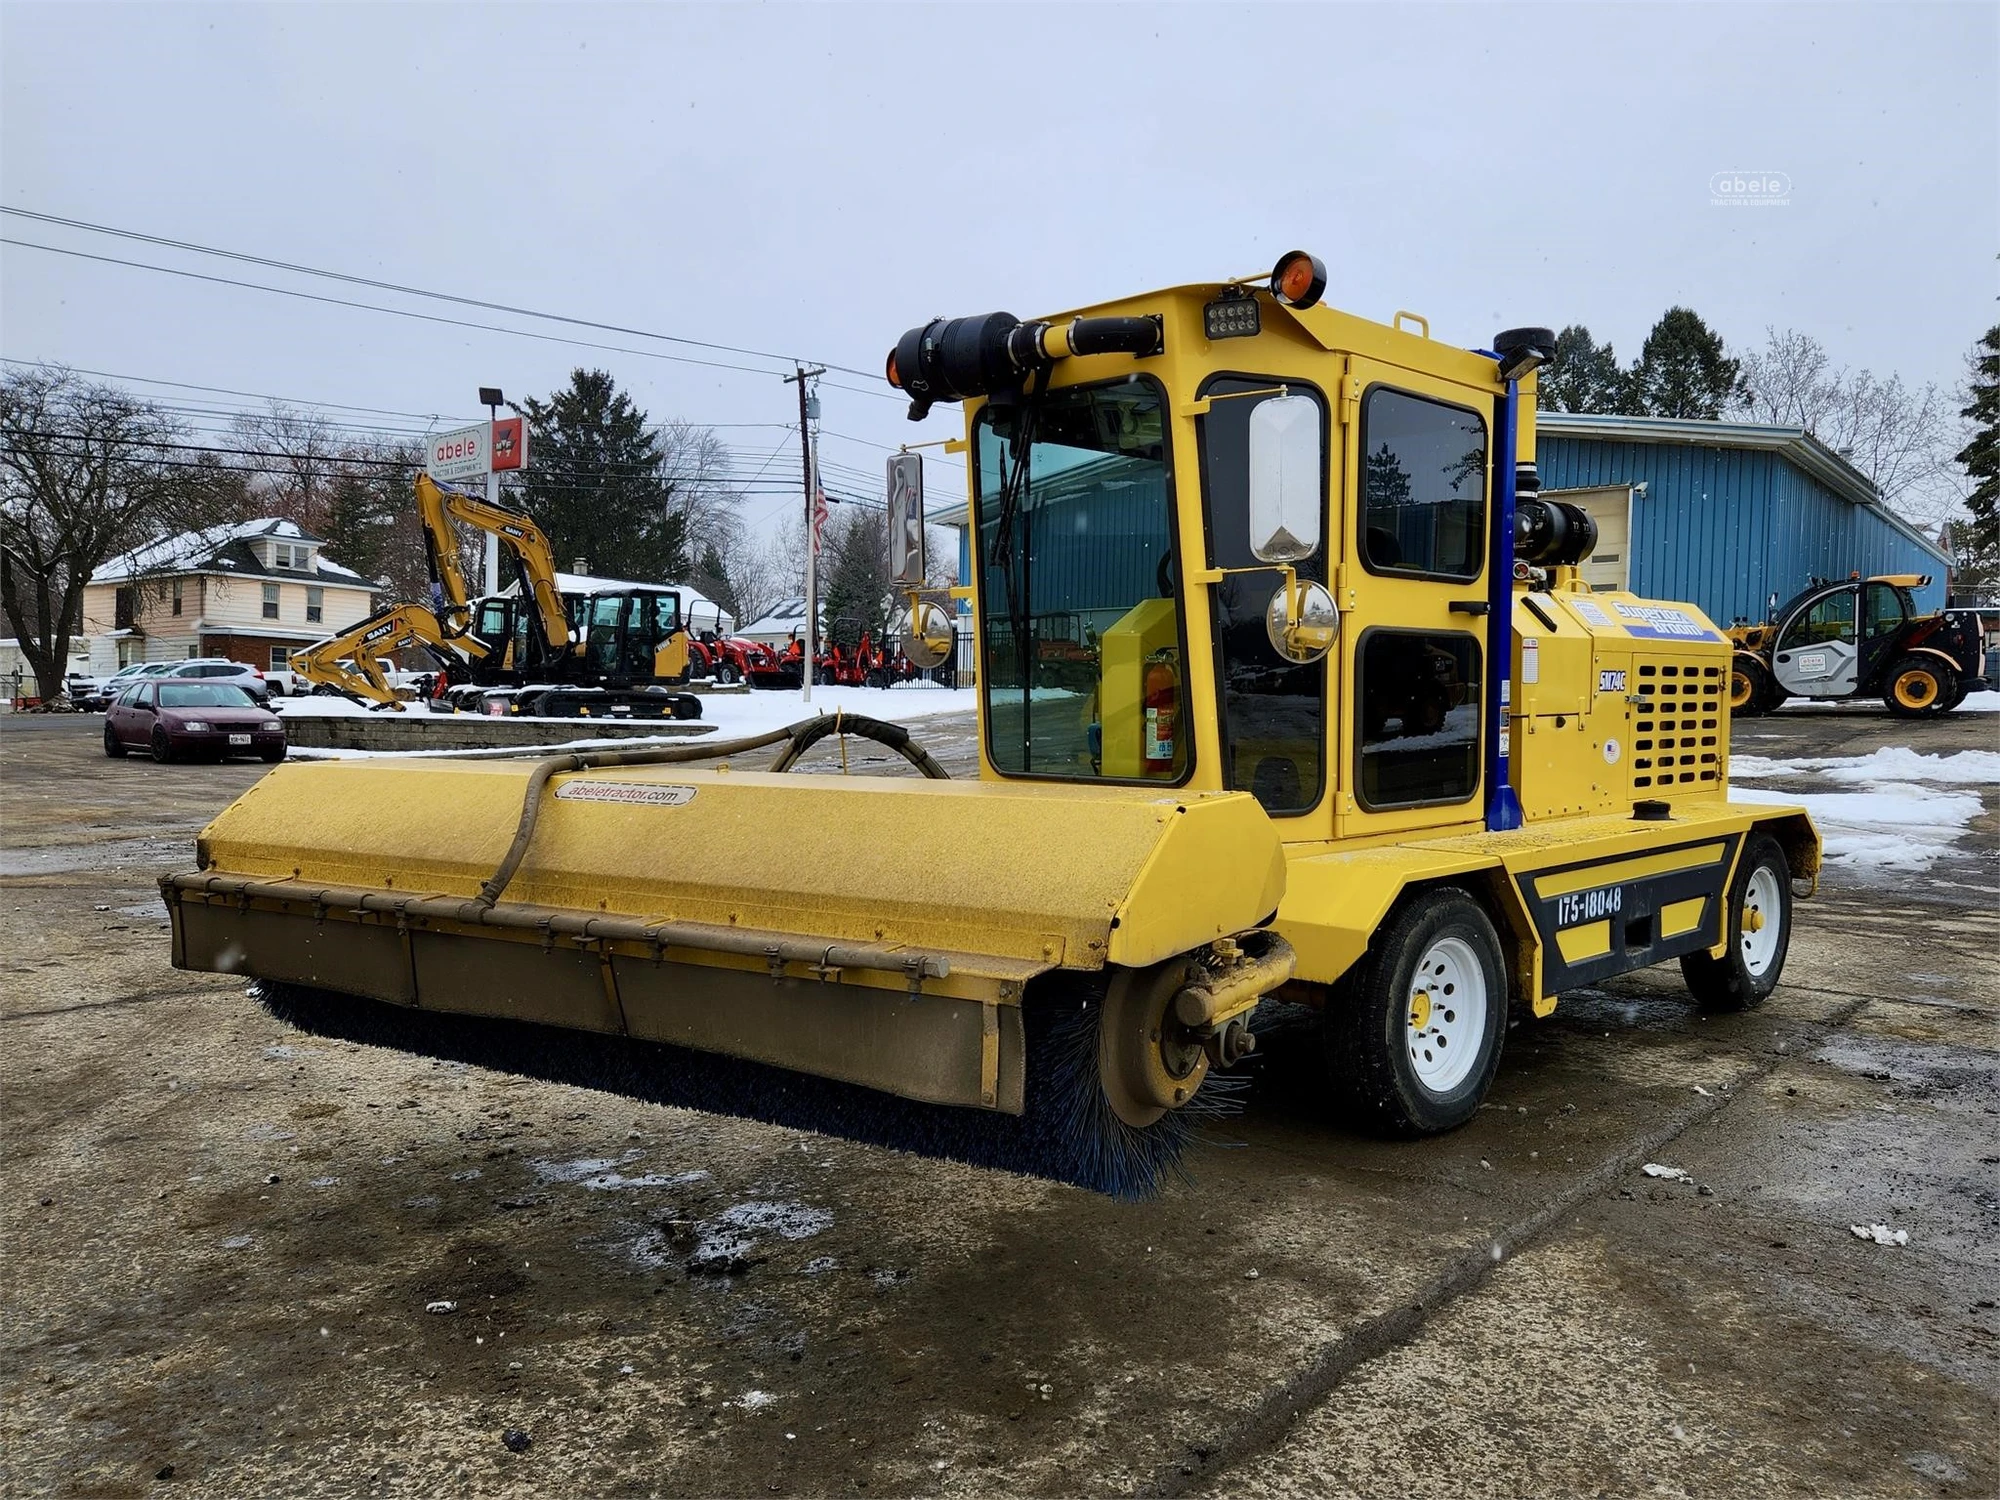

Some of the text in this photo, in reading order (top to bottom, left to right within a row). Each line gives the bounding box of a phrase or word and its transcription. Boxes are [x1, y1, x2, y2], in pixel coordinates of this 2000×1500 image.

[437, 437, 475, 461] abele
[505, 526, 522, 537] SANY
[367, 624, 391, 640] SANY
[1599, 670, 1626, 692] SM74C
[568, 785, 679, 801] abeletractor.com
[1559, 887, 1621, 925] 175-18048
